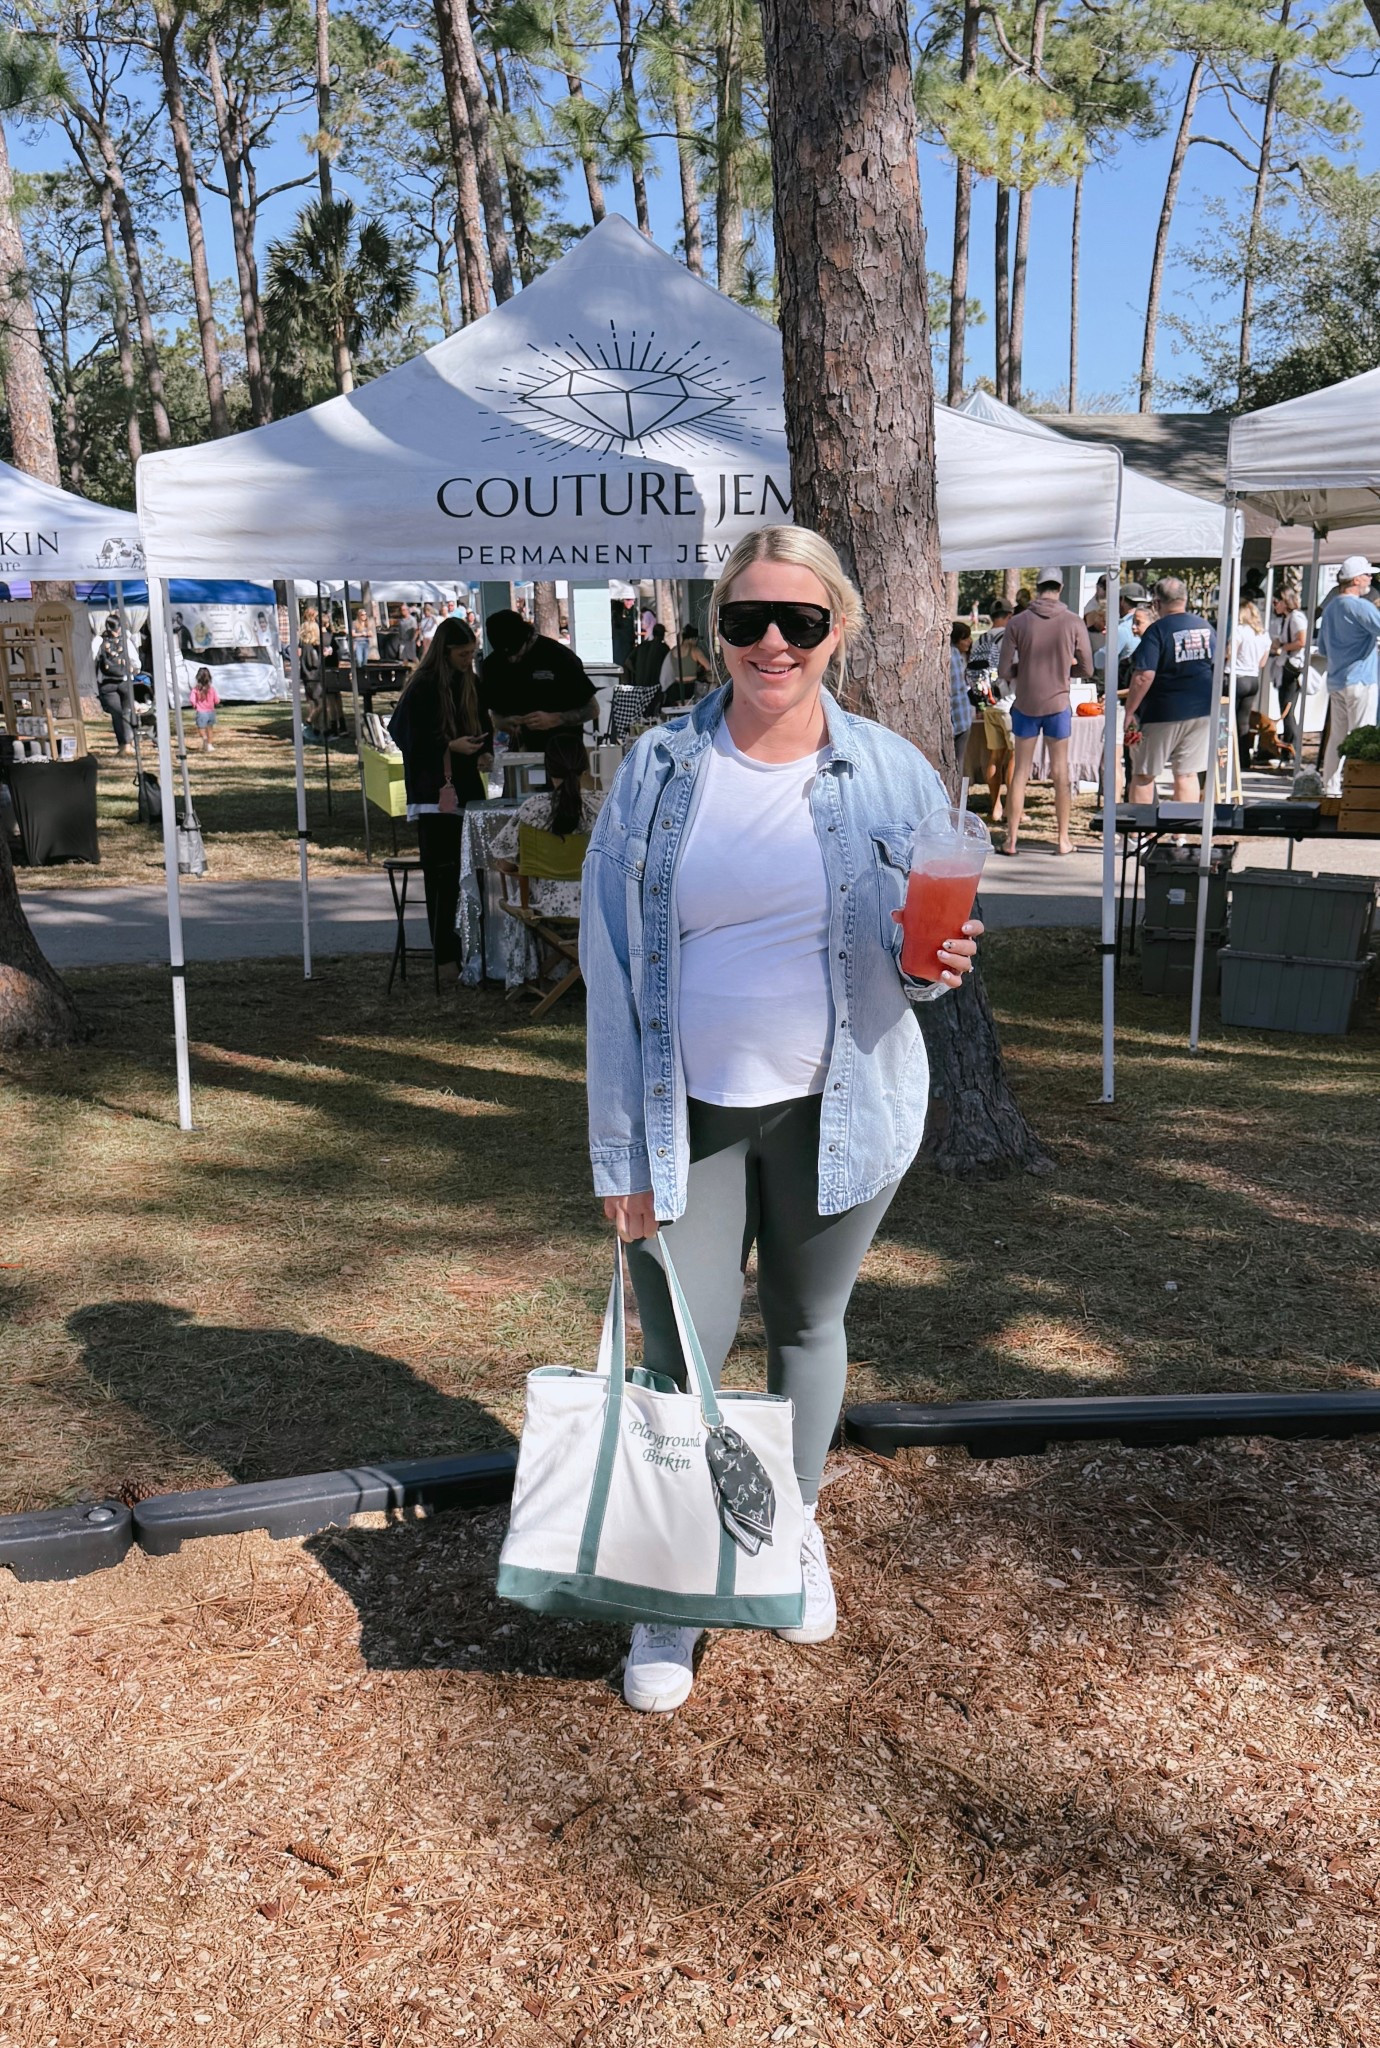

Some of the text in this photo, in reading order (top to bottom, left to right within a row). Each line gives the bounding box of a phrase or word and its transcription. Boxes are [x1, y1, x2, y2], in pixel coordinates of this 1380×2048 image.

[436, 471, 696, 518] COUTURE
[0, 531, 59, 555] KIN
[458, 544, 653, 565] PERMANENT
[628, 1421, 700, 1448] Playground
[642, 1448, 691, 1472] Birkin
